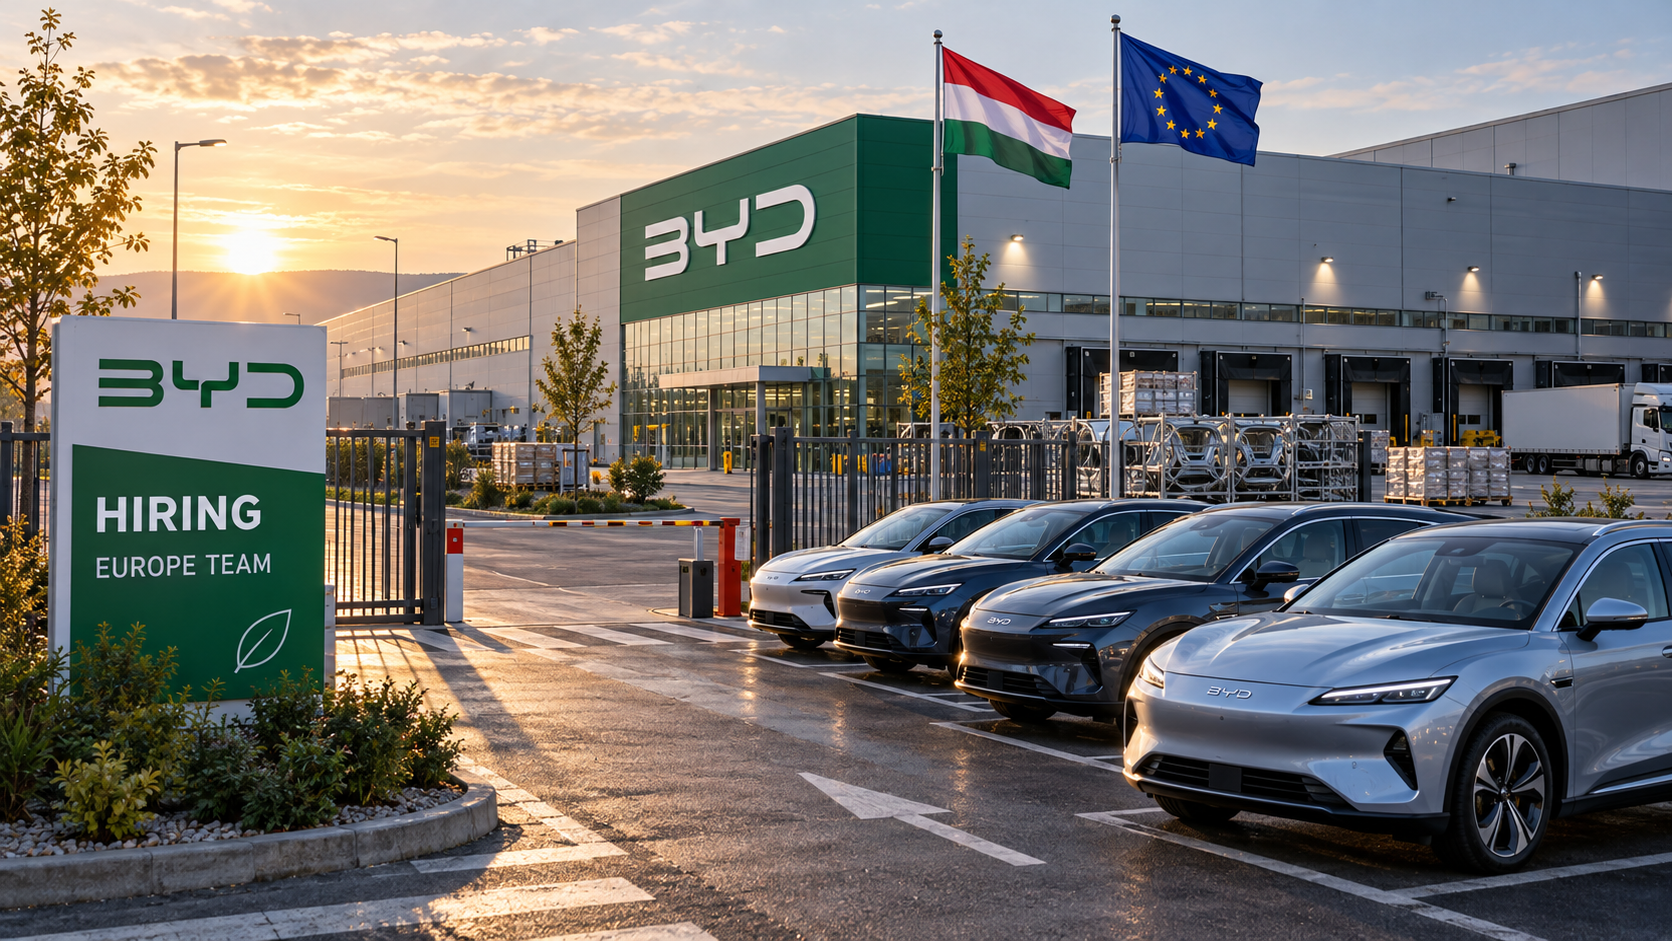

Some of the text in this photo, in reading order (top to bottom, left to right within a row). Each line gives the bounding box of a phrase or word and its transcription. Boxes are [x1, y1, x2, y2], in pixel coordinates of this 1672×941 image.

[644, 184, 816, 282] BYD
[98, 358, 305, 409] BYD
[96, 494, 262, 533] HIRING
[96, 553, 271, 579] EUROPE TEAM
[1207, 685, 1252, 699] BYD
